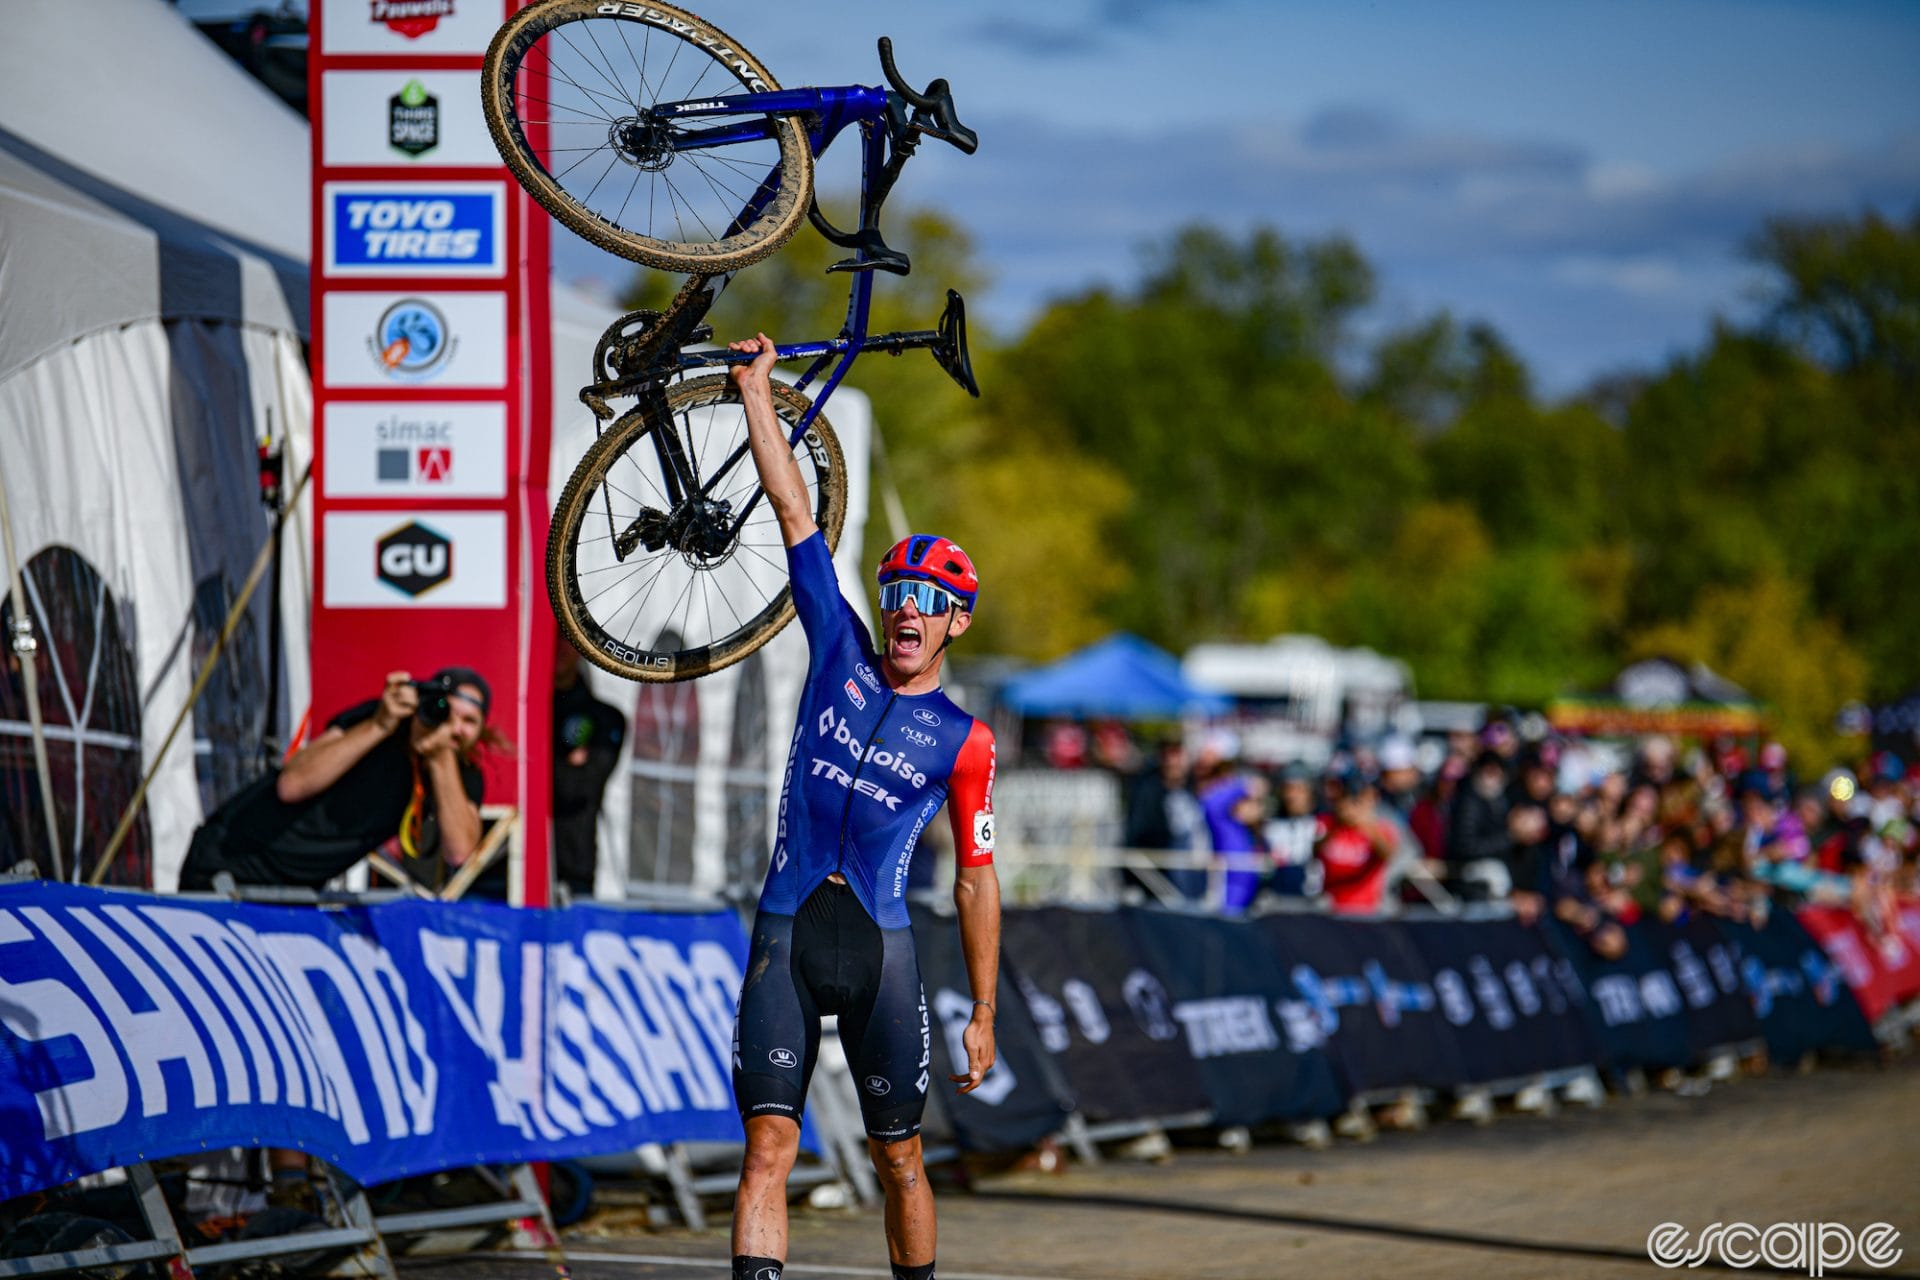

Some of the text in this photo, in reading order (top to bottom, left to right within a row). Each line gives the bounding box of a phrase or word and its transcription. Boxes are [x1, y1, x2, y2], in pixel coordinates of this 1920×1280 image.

[675, 101, 729, 112] TREK
[347, 200, 455, 230] TOYO
[363, 229, 482, 259] TIRES
[375, 414, 453, 442] simac
[380, 544, 446, 577] GU
[604, 640, 669, 669] AEOLUS
[834, 717, 927, 789] baloise
[779, 724, 804, 838] baloise
[811, 758, 903, 811] TREK
[981, 821, 991, 841] 6
[893, 867, 903, 898] BAINS
[917, 982, 930, 1068] baloi
[752, 1102, 794, 1112] BONTRAGER
